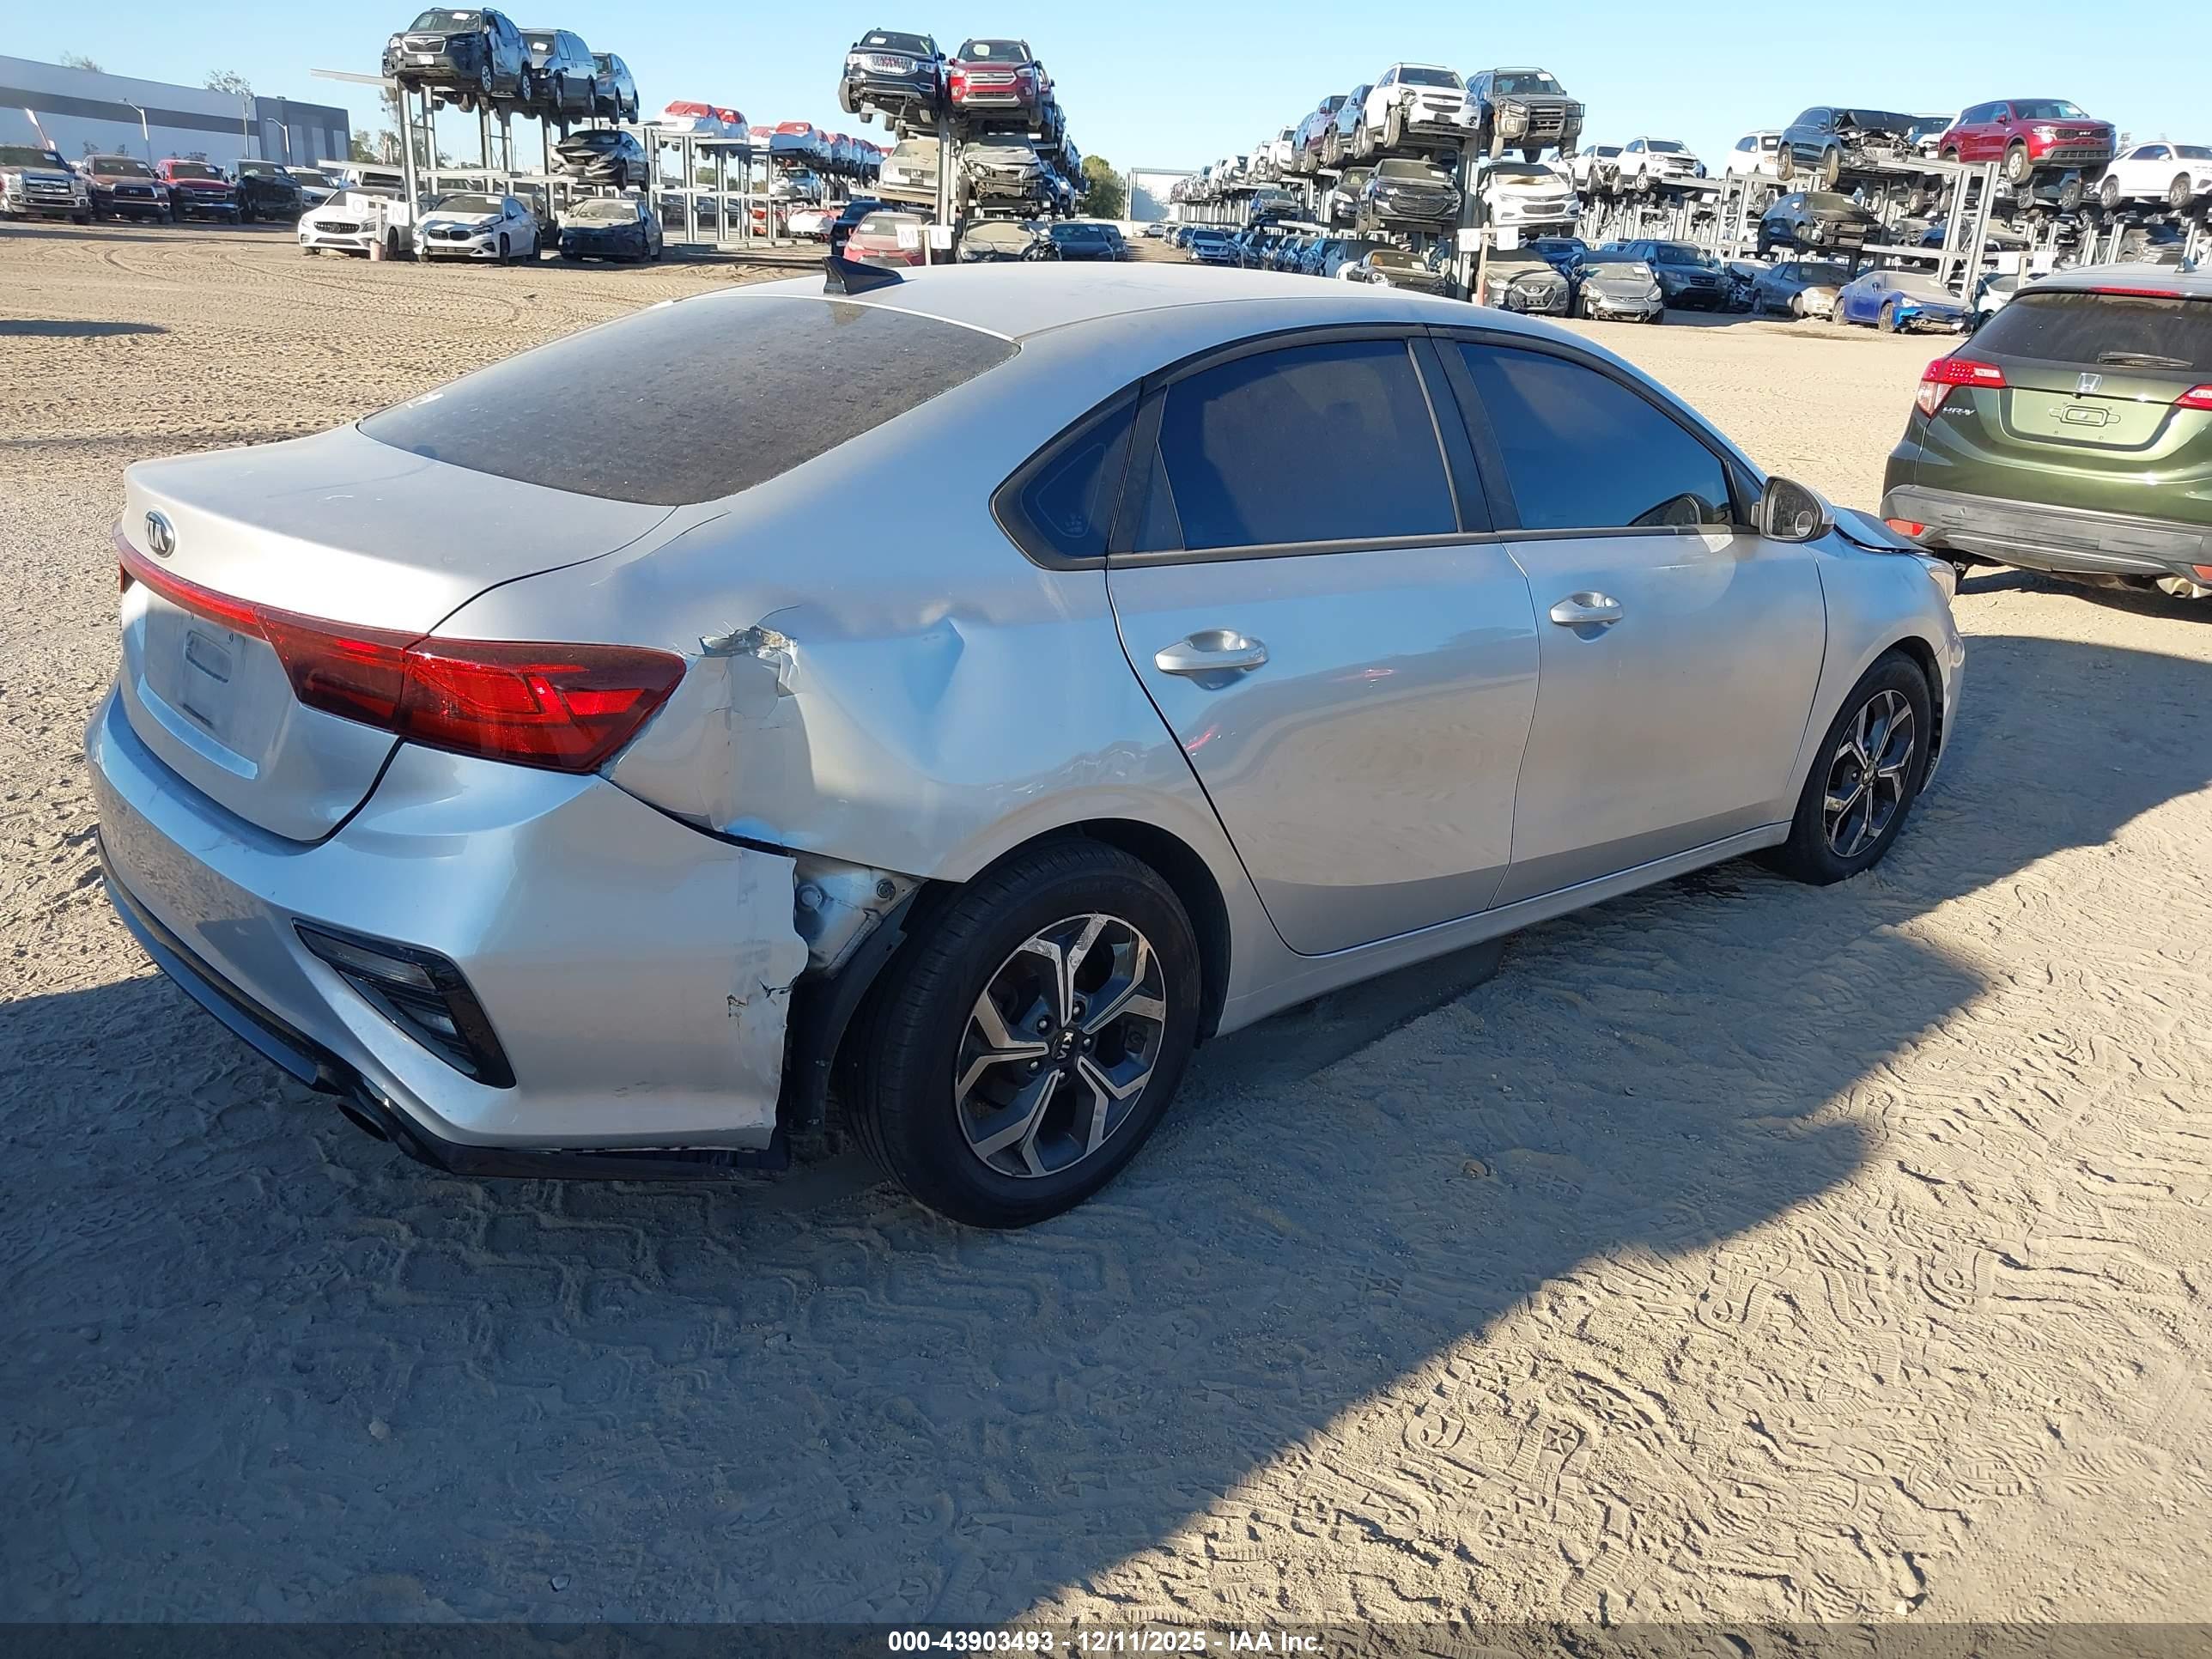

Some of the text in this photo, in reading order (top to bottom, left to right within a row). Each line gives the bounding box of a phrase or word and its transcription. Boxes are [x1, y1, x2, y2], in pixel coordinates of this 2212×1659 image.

[392, 206, 405, 222] N
[899, 230, 915, 244] M
[936, 231, 946, 246] L
[1464, 233, 1476, 248] K
[1056, 1031, 1074, 1060] KIA
